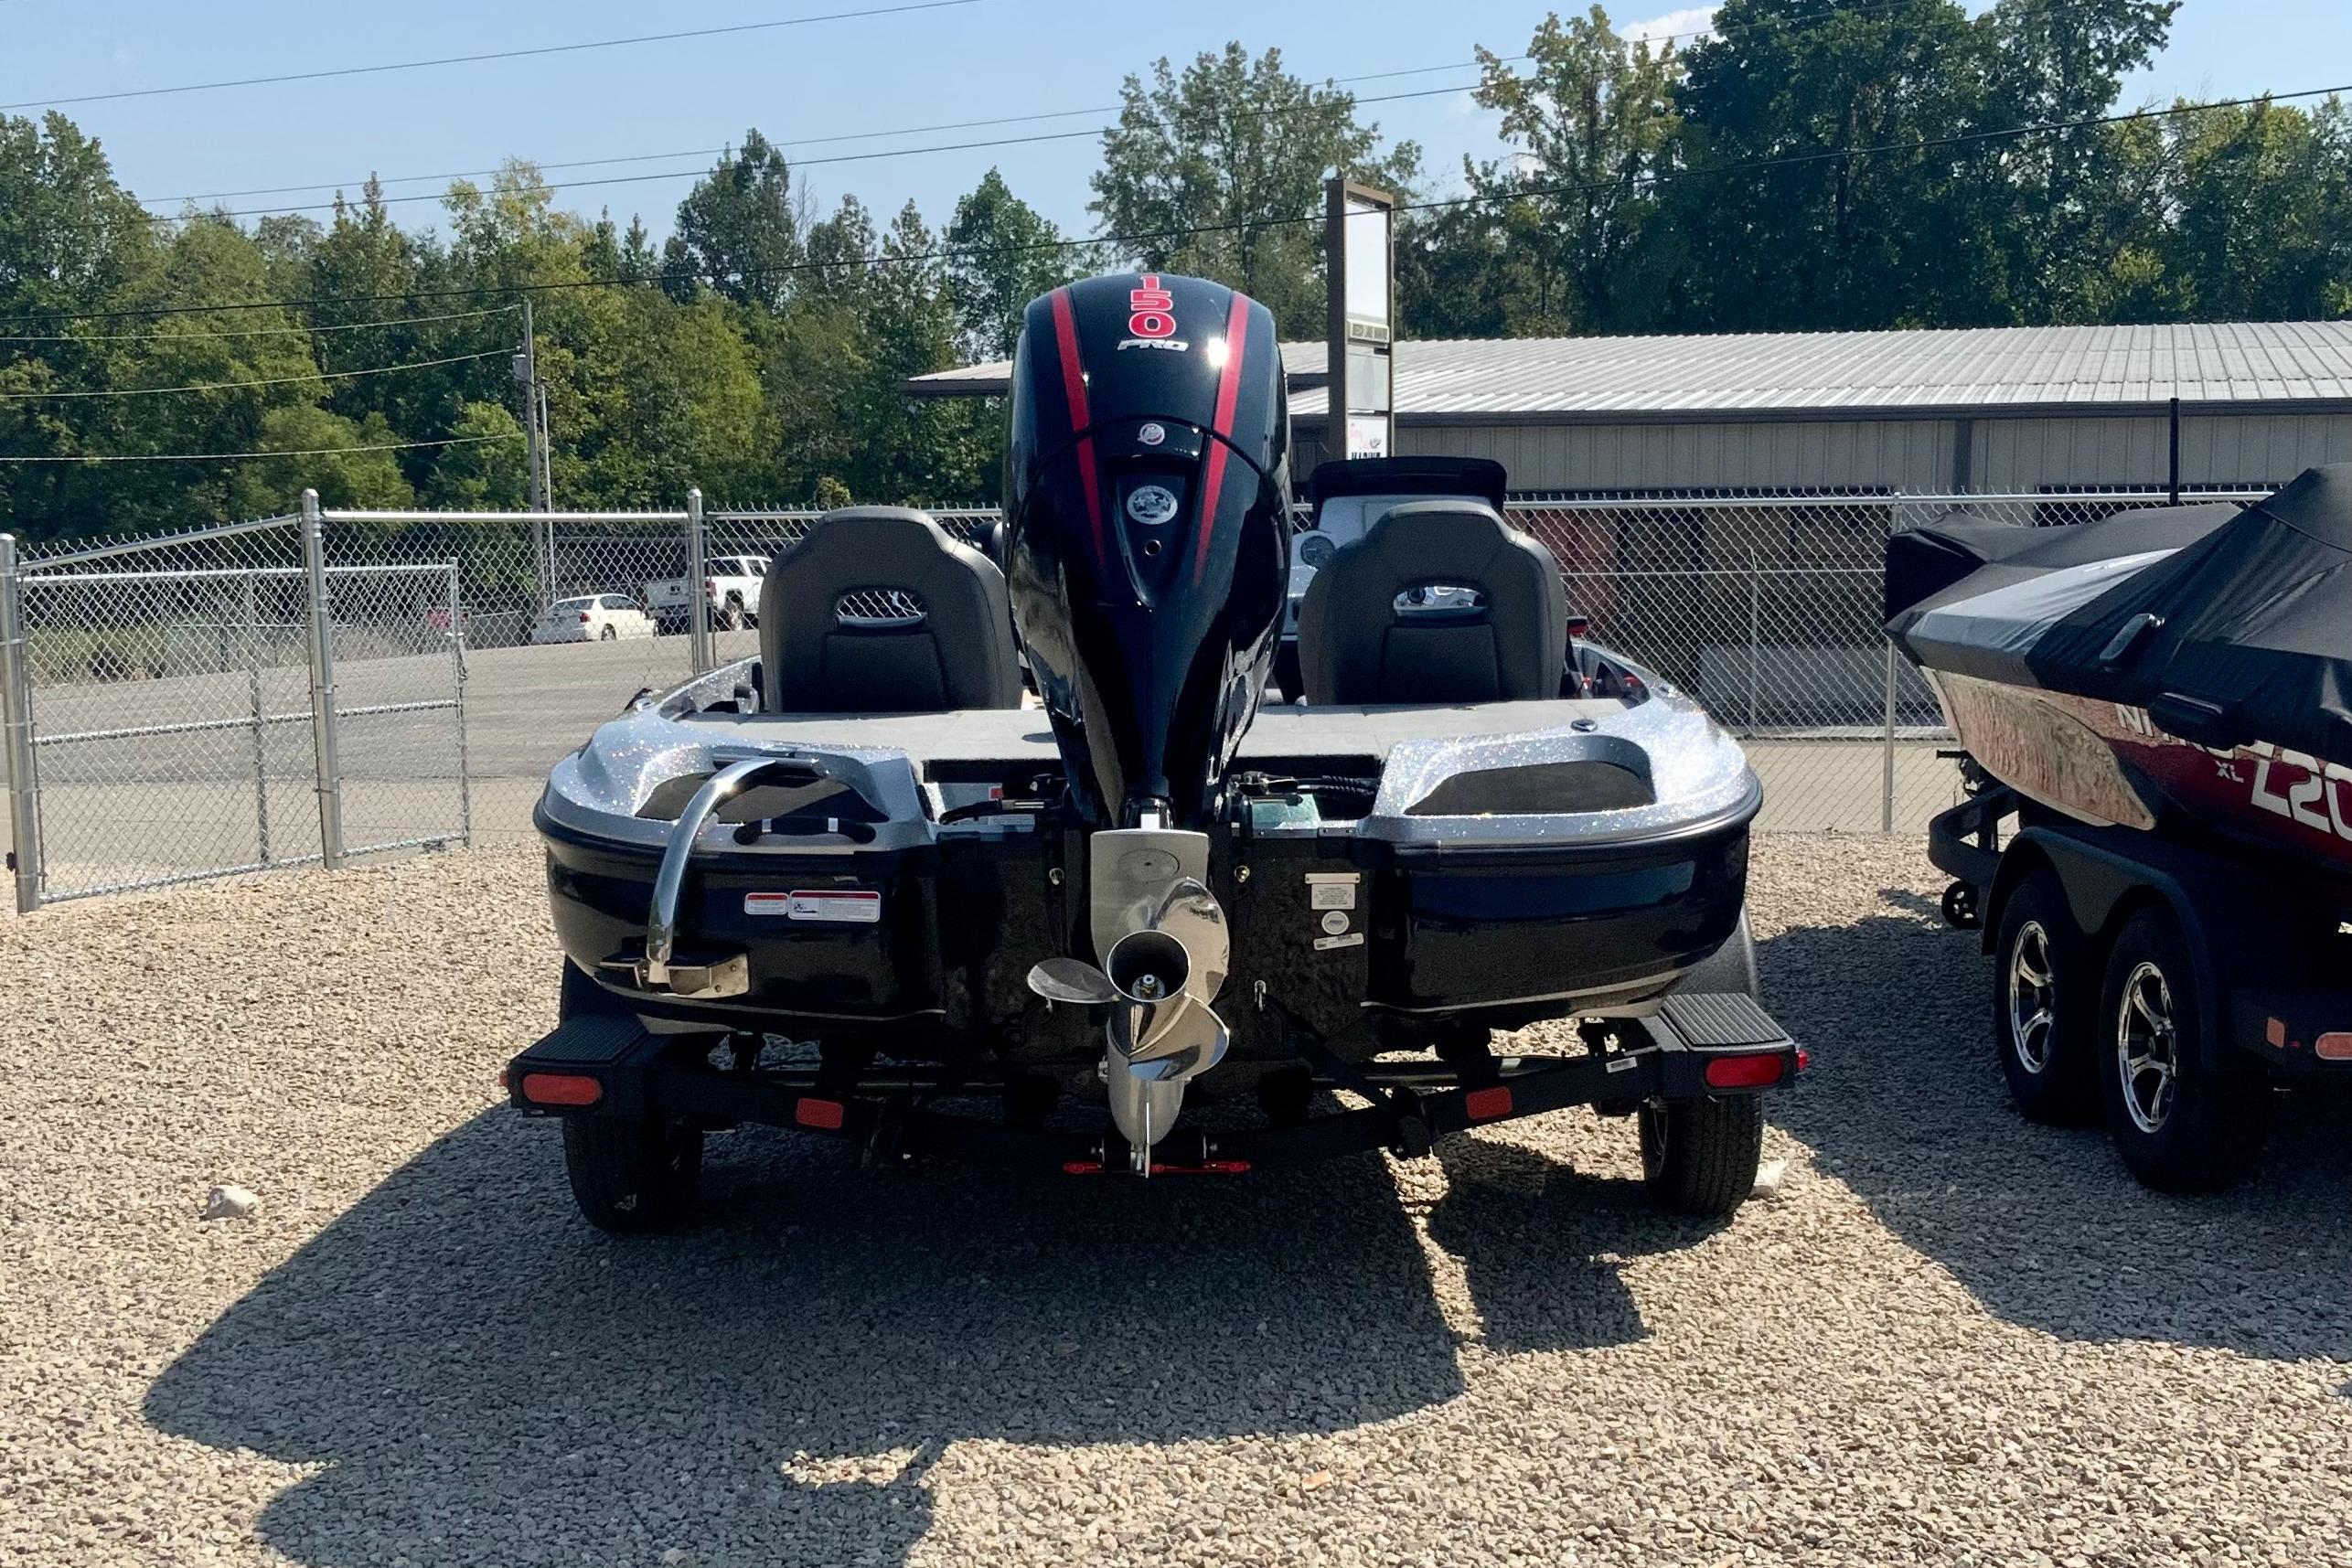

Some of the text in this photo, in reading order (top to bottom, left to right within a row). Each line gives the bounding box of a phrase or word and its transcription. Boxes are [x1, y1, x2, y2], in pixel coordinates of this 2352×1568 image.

[1128, 273, 1176, 338] 150
[1117, 339, 1189, 352] PRO
[2214, 759, 2244, 784] XL
